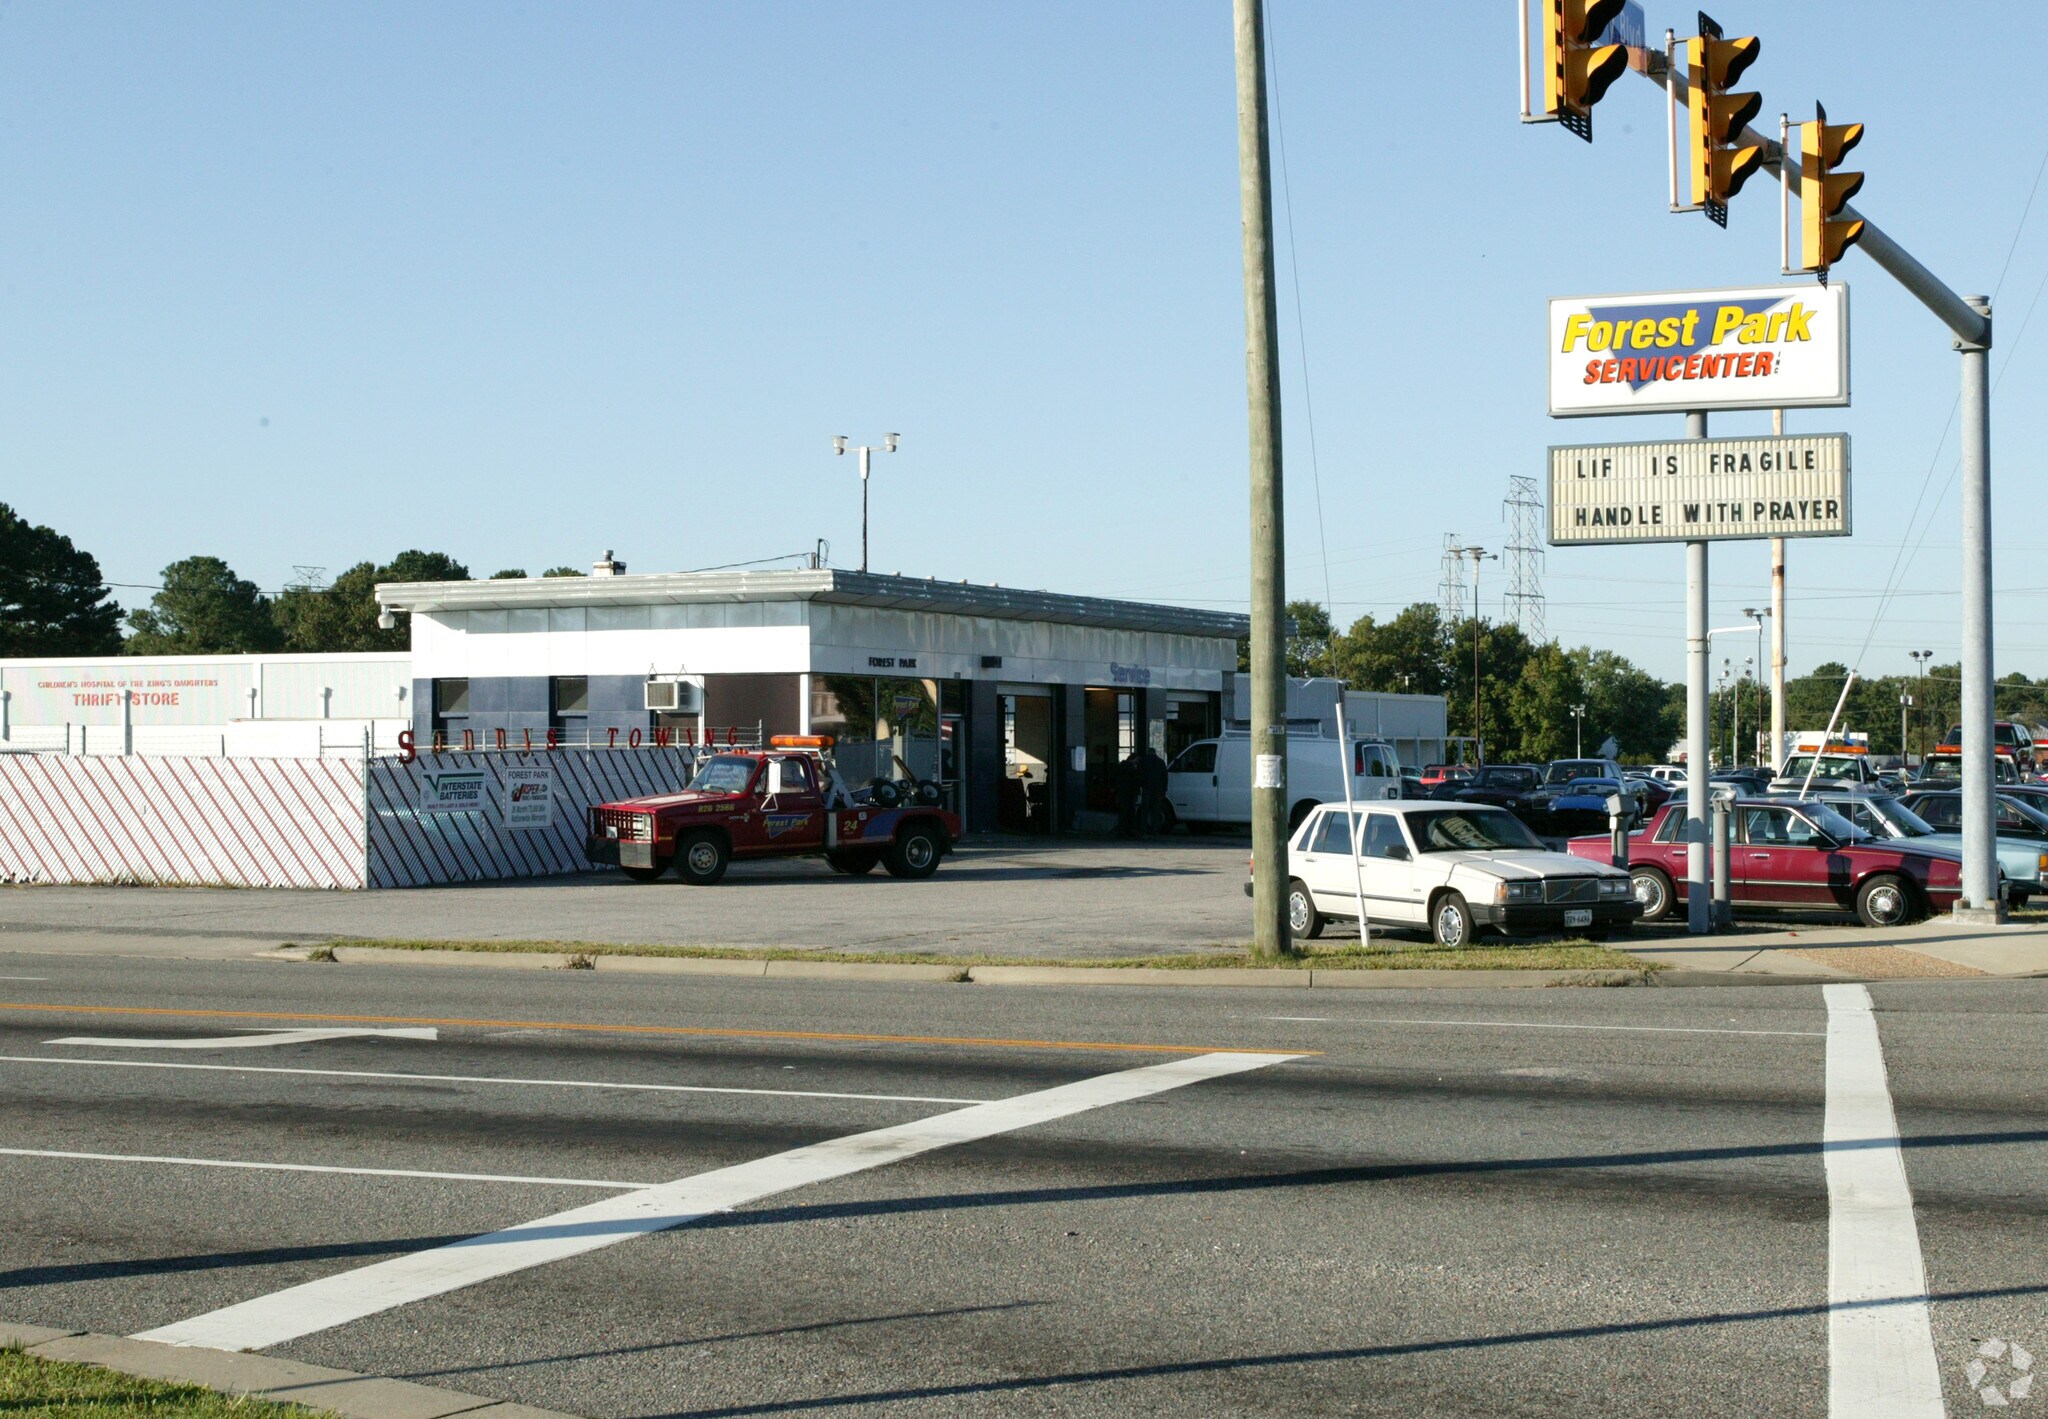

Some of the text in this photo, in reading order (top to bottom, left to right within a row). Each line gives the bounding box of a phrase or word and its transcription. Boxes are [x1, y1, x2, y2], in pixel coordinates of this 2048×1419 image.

[1620, 10, 1641, 47] Blvd
[1561, 302, 1817, 353] Forest Park
[1583, 351, 1774, 384] SERVICENTER
[1577, 450, 1815, 478] LIF IS FRAGILE
[1576, 499, 1838, 527] HANDLE WITH PRAYER
[868, 657, 916, 668] FOREST PARK
[1110, 662, 1151, 685] Service
[81, 680, 115, 688] HOSPITAL
[118, 680, 126, 688] OF
[130, 680, 143, 688] THE
[174, 679, 218, 687] DAUGHTERS
[72, 692, 179, 706] THRIFT STORE
[606, 726, 738, 748] TOWING
[508, 771, 549, 779] FOREST PARK
[441, 781, 483, 791] INTERSTATE
[440, 790, 478, 800] BATTERIES
[763, 818, 789, 828] Forest
[844, 820, 858, 831] 24
